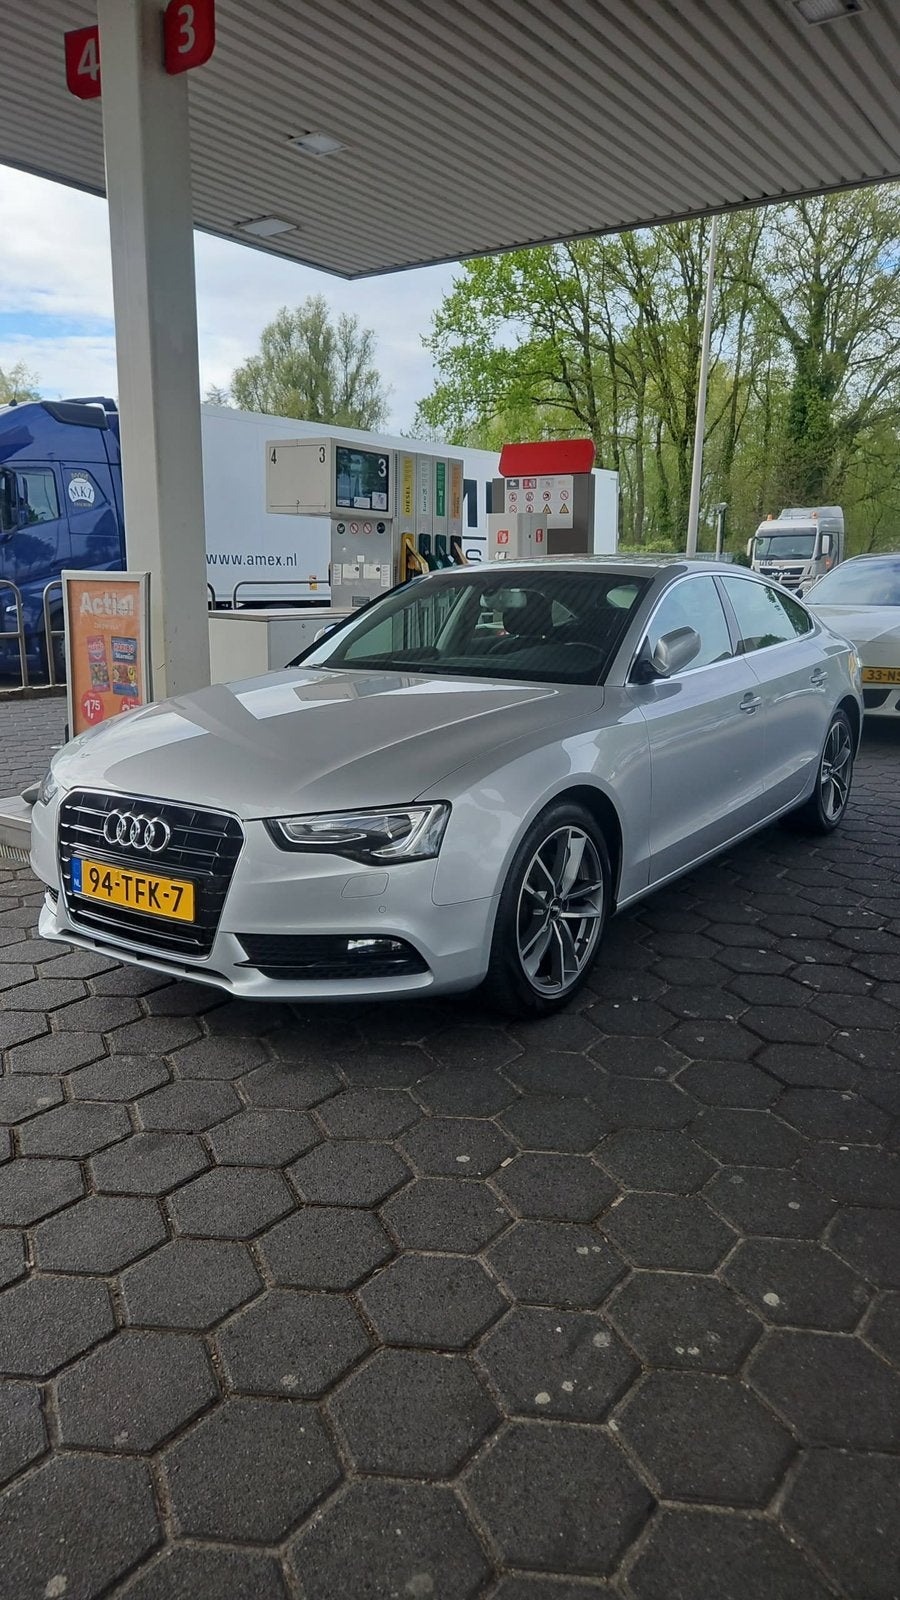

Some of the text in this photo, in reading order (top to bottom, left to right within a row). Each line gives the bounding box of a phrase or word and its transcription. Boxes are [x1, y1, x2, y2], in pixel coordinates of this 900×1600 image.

[178, 4, 195, 54] 3
[77, 37, 100, 81] 4
[270, 447, 326, 464] 4 3
[378, 458, 387, 478] 3
[206, 553, 298, 567] www.amex.nl
[88, 867, 184, 912] 94-TFK-7
